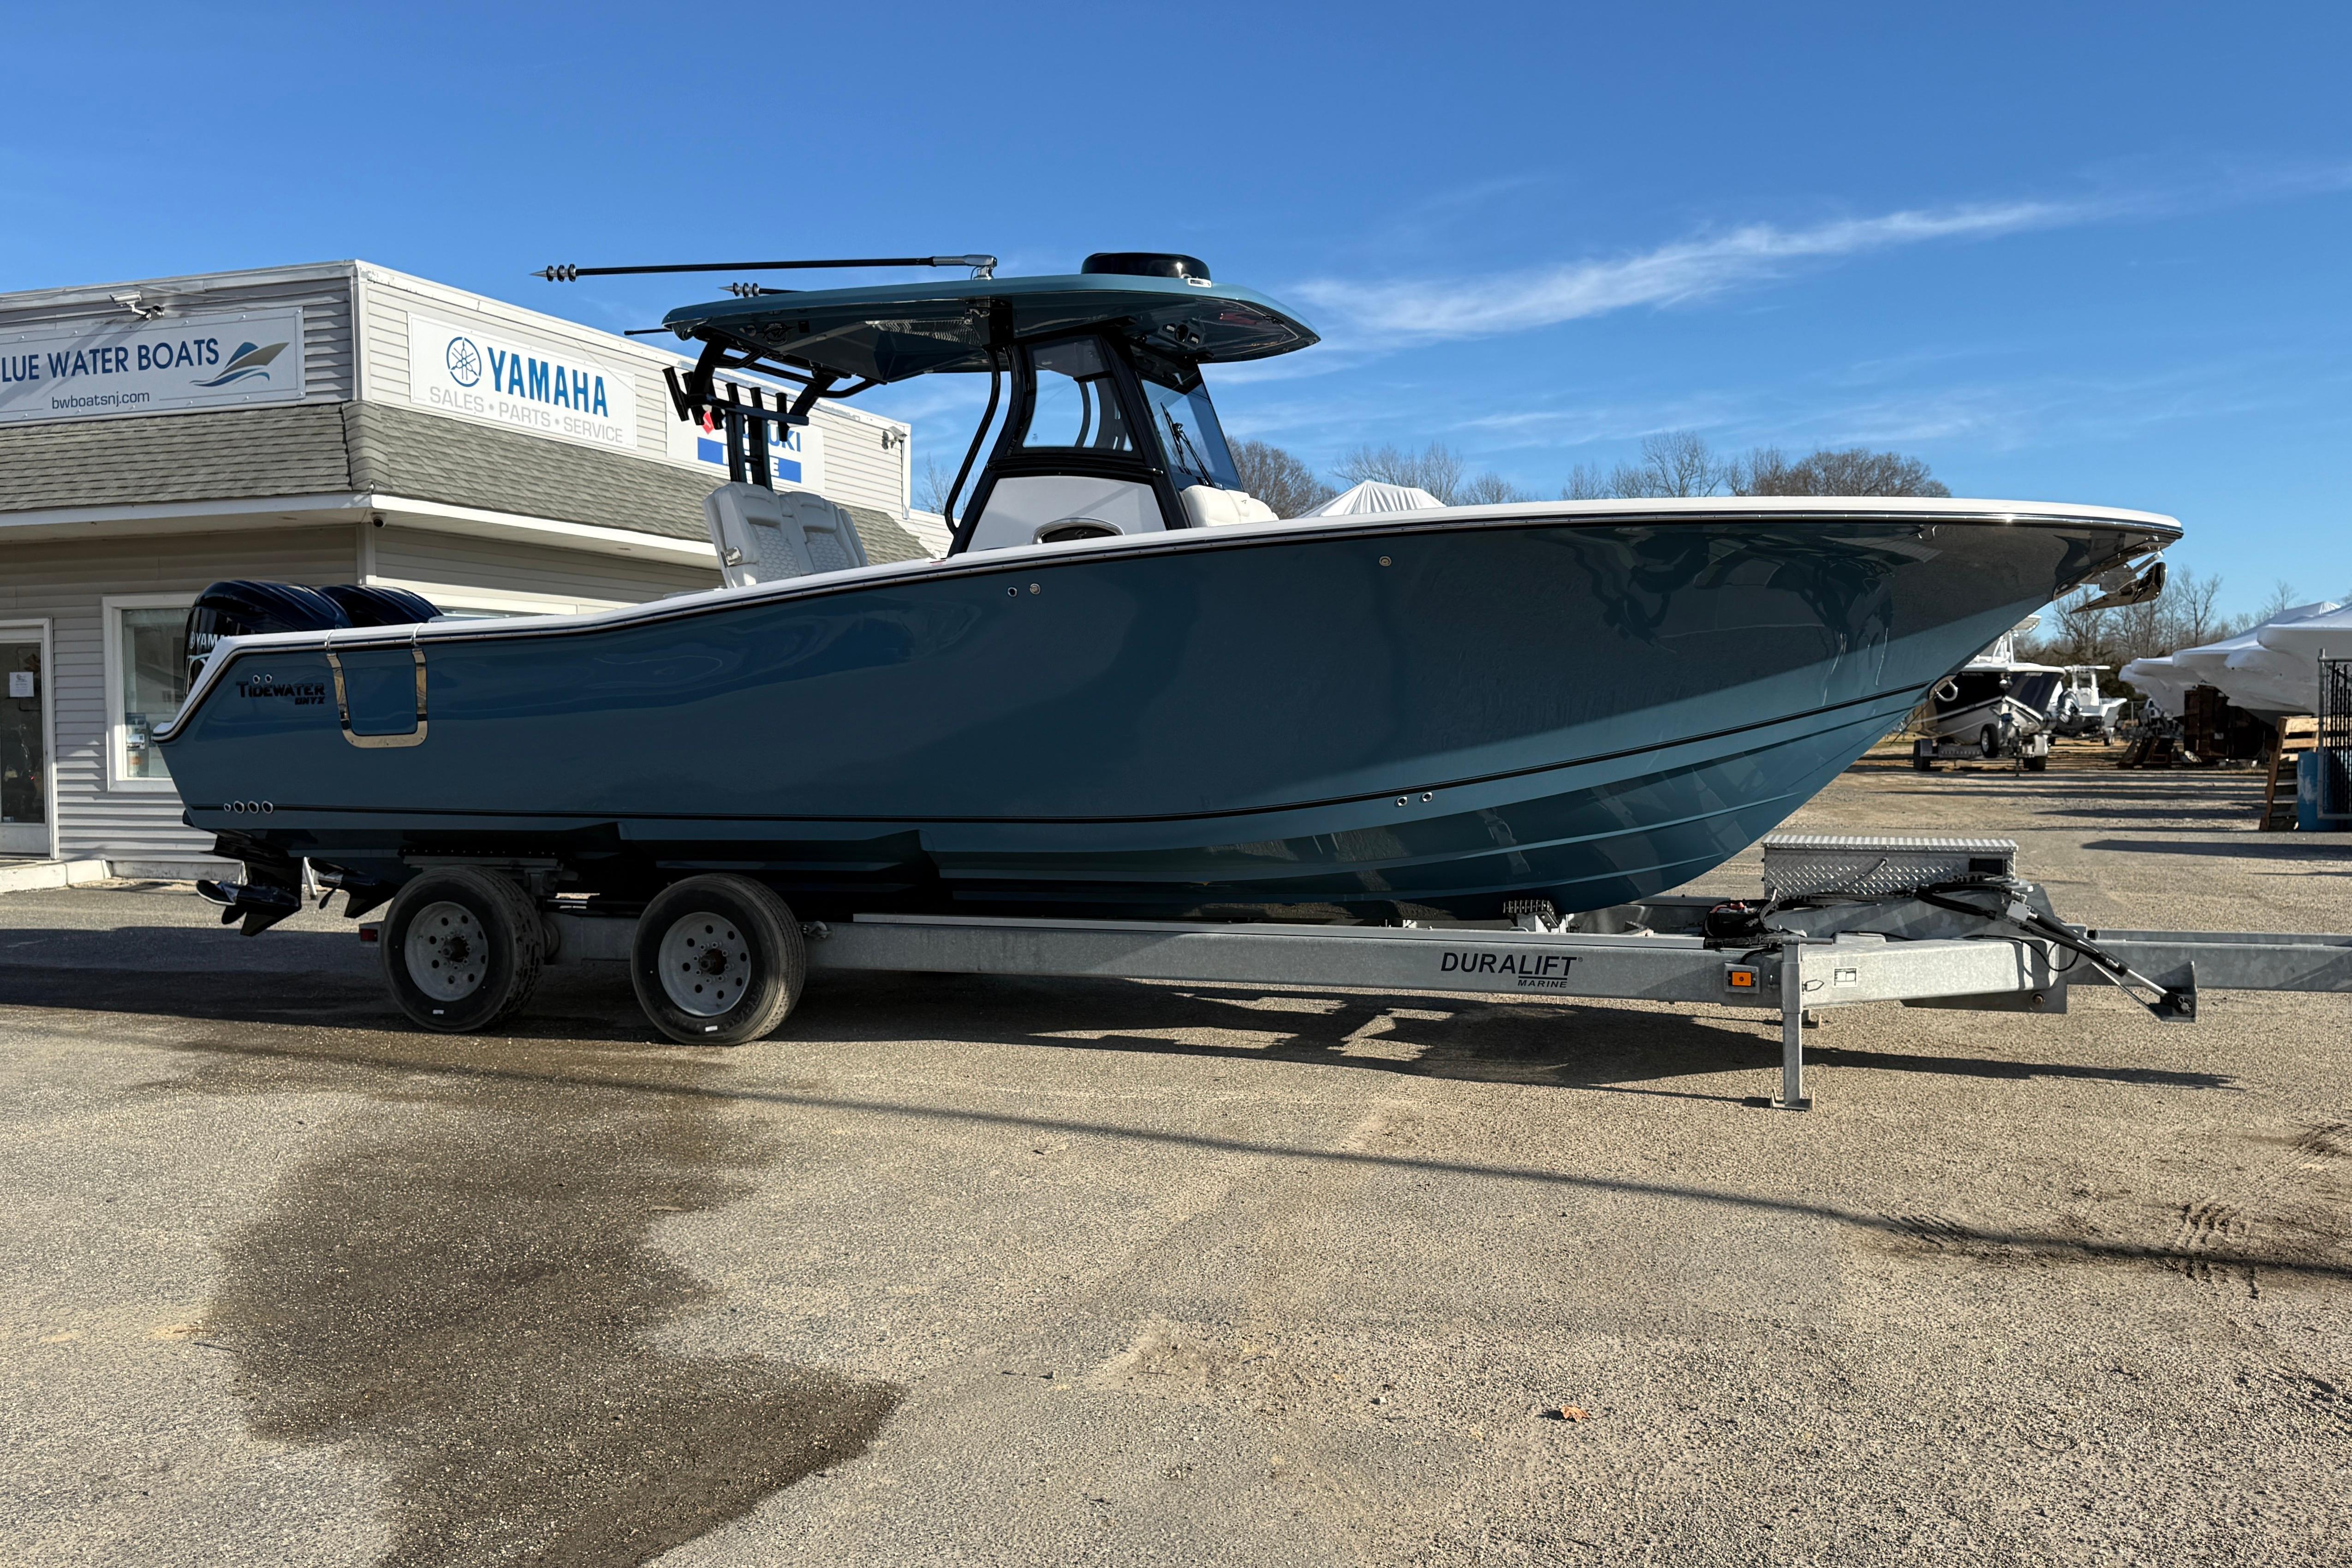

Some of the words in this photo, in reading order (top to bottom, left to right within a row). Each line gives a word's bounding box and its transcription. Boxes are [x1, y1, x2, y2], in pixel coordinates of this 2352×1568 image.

[1, 354, 40, 382] LUE
[48, 346, 129, 379] WATER
[137, 338, 220, 371] BOATS
[487, 346, 608, 418] YAMAHA
[52, 391, 150, 410] bwboatsnj.com
[429, 386, 484, 413] SALES
[499, 401, 551, 428] PARTS
[563, 416, 623, 443] SERVICE
[196, 632, 229, 650] YAM
[236, 680, 325, 698] TIDEWATER
[295, 696, 325, 705] ONYX
[1518, 979, 1567, 988] MARINE
